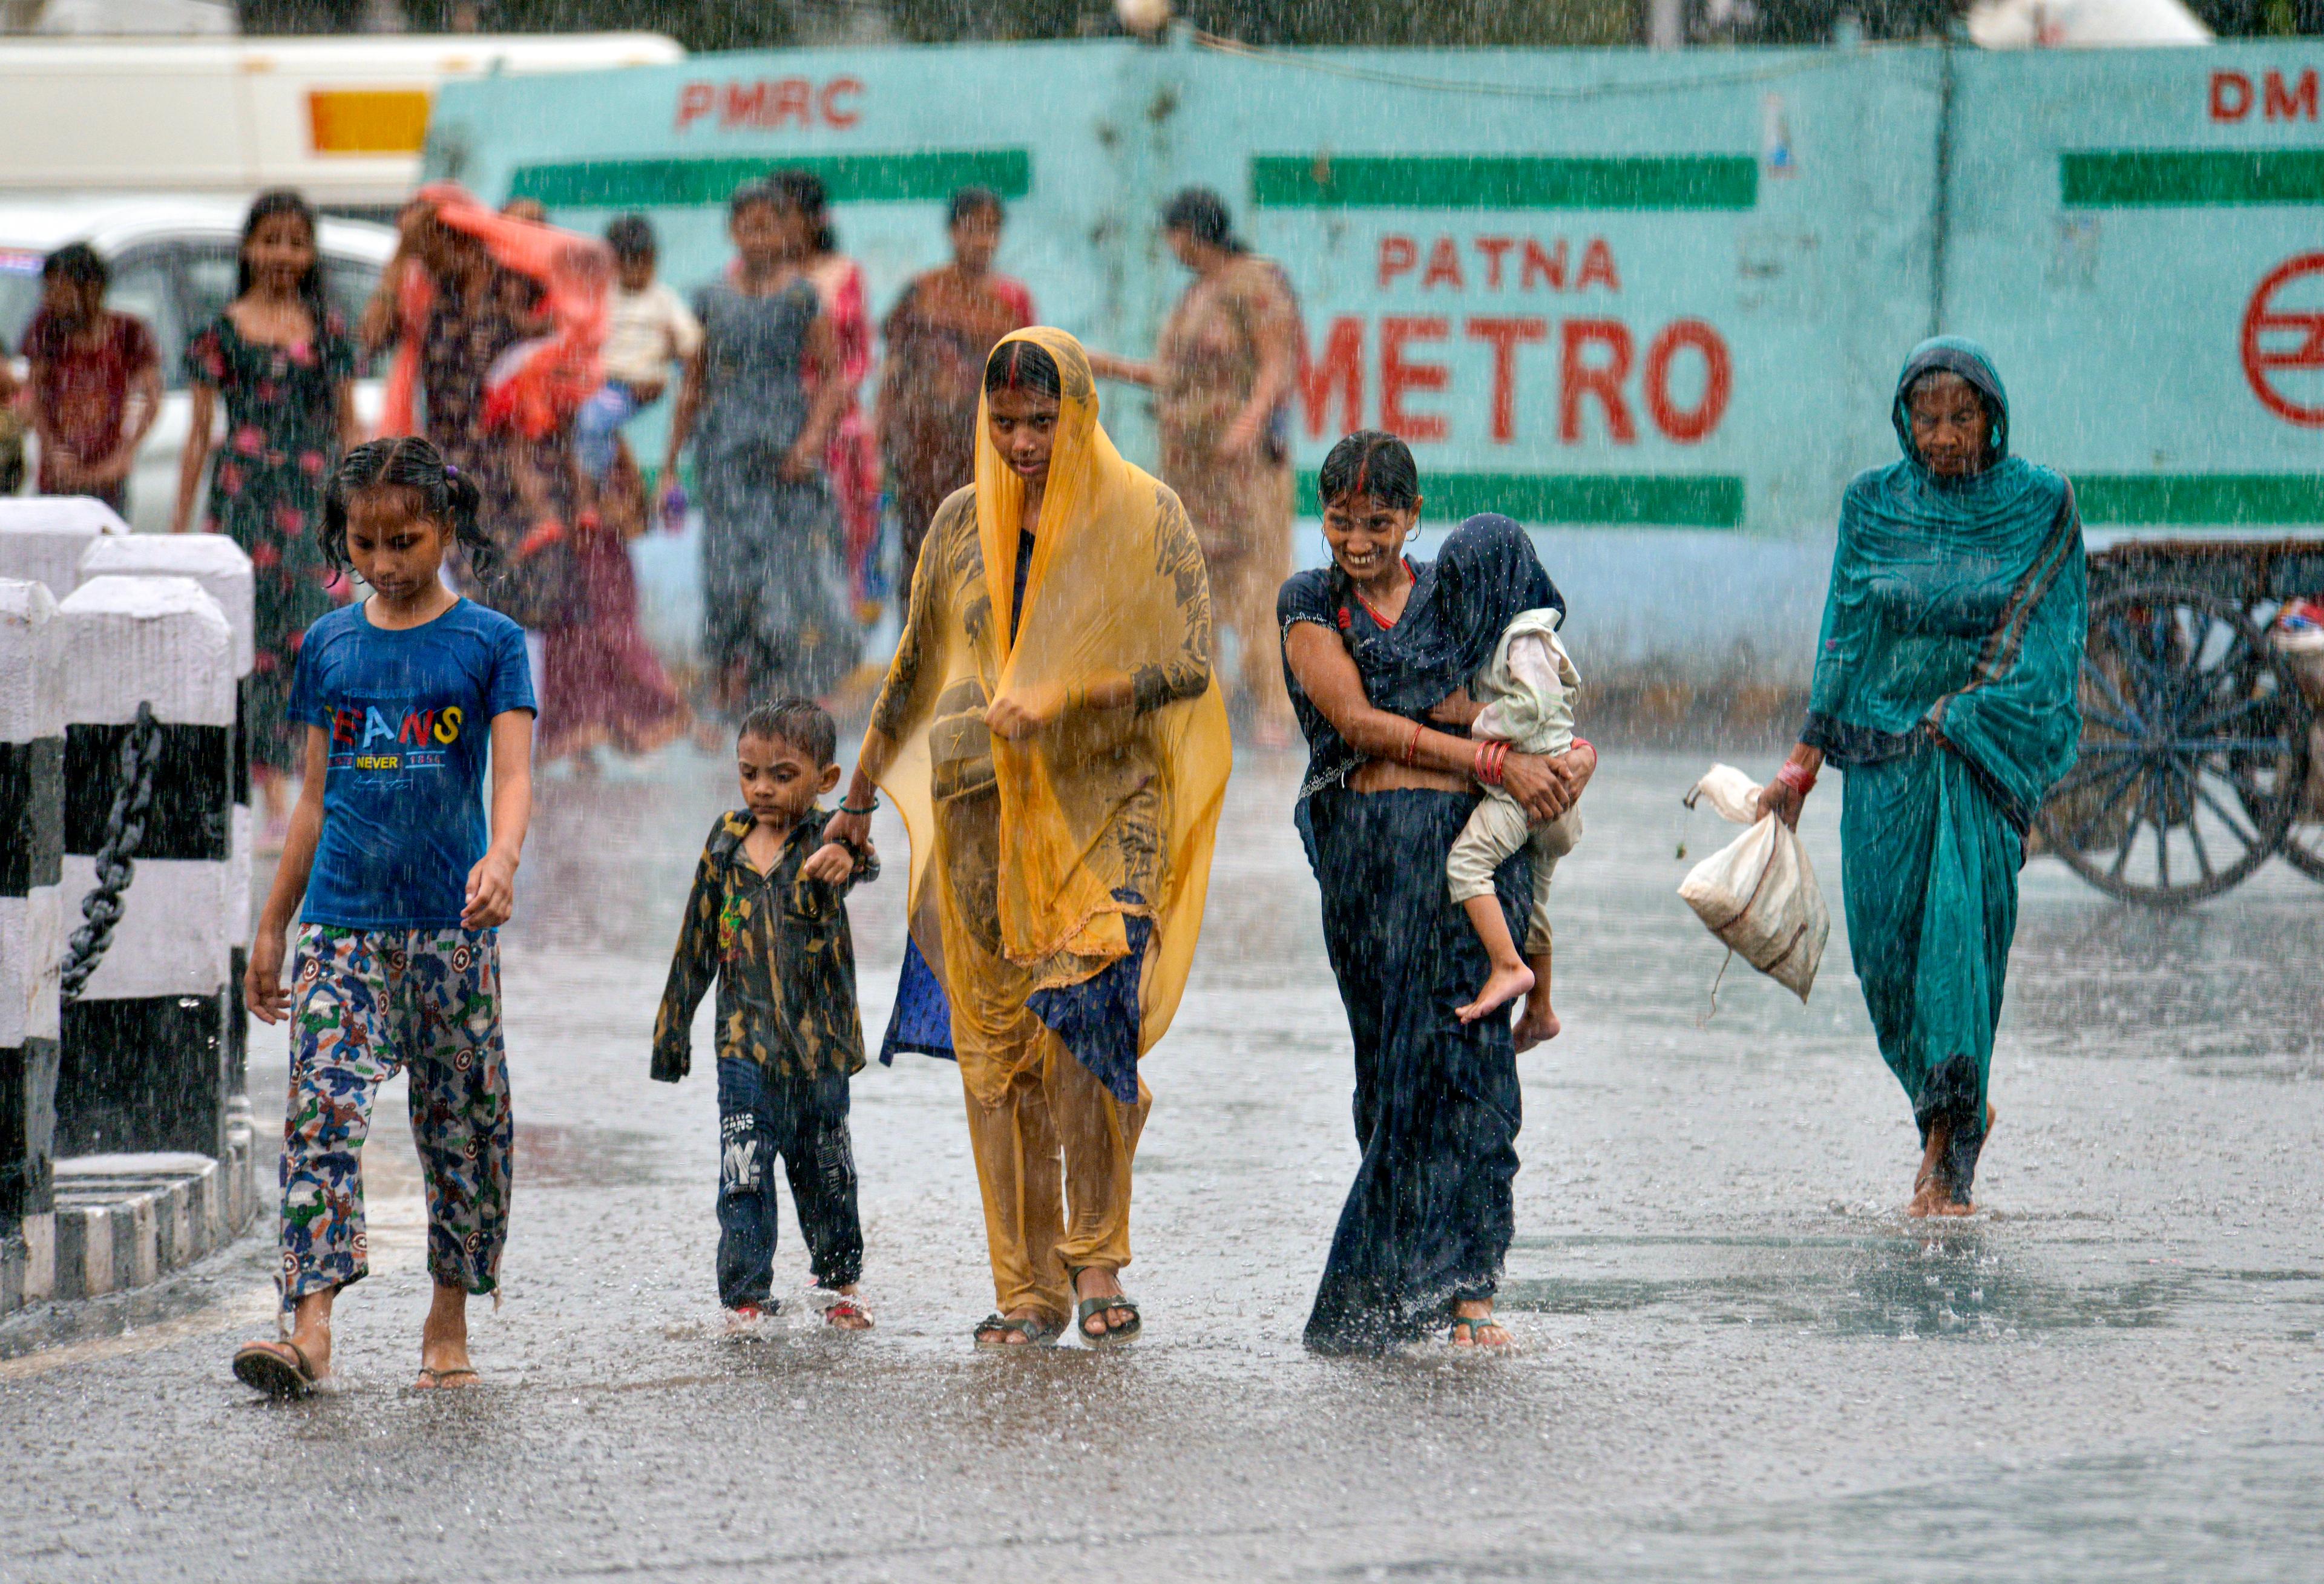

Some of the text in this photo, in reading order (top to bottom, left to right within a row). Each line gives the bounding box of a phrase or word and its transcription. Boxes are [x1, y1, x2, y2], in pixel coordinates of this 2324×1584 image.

[677, 77, 865, 131] PMRC
[2209, 68, 2318, 122] DM
[1377, 232, 1621, 291] PATNA
[1295, 316, 1733, 443] METRO
[325, 704, 462, 748] EANS
[356, 756, 398, 770] NEVER
